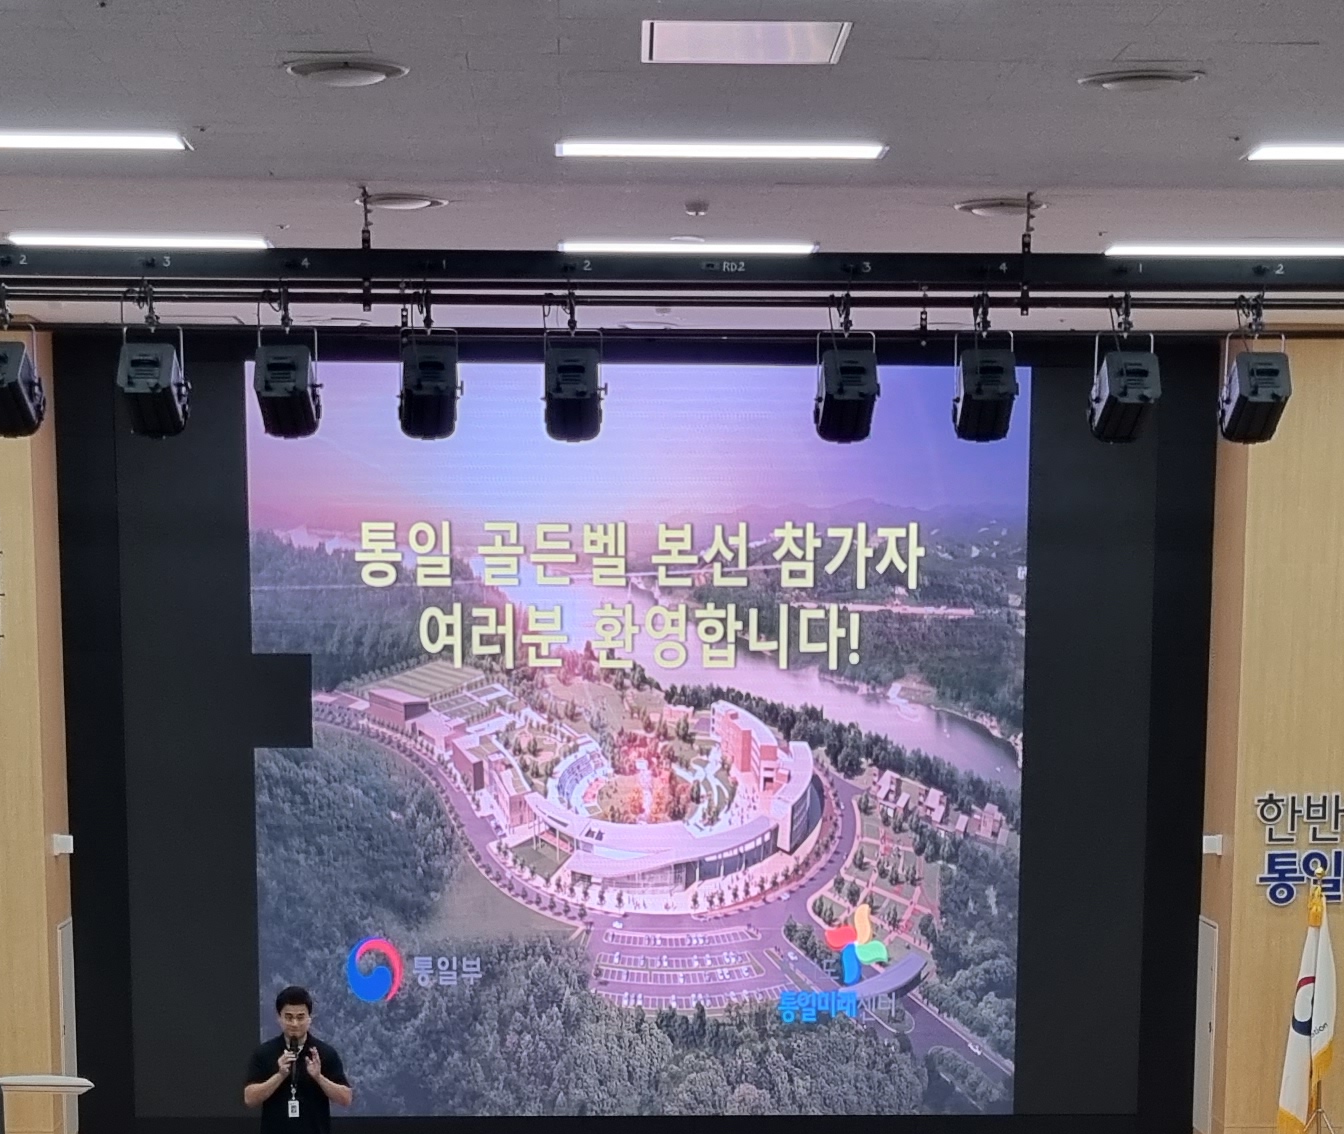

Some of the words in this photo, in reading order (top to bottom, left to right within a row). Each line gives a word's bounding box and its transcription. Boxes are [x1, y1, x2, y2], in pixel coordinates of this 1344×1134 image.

[722, 261, 746, 272] RD2
[355, 520, 452, 587] 통일
[478, 520, 628, 587] 골든벨
[651, 521, 749, 587] 본선
[772, 521, 925, 588] 참가자
[418, 602, 568, 670] 여러분
[592, 602, 862, 670] 환영합니다!
[412, 956, 483, 987] 통일부
